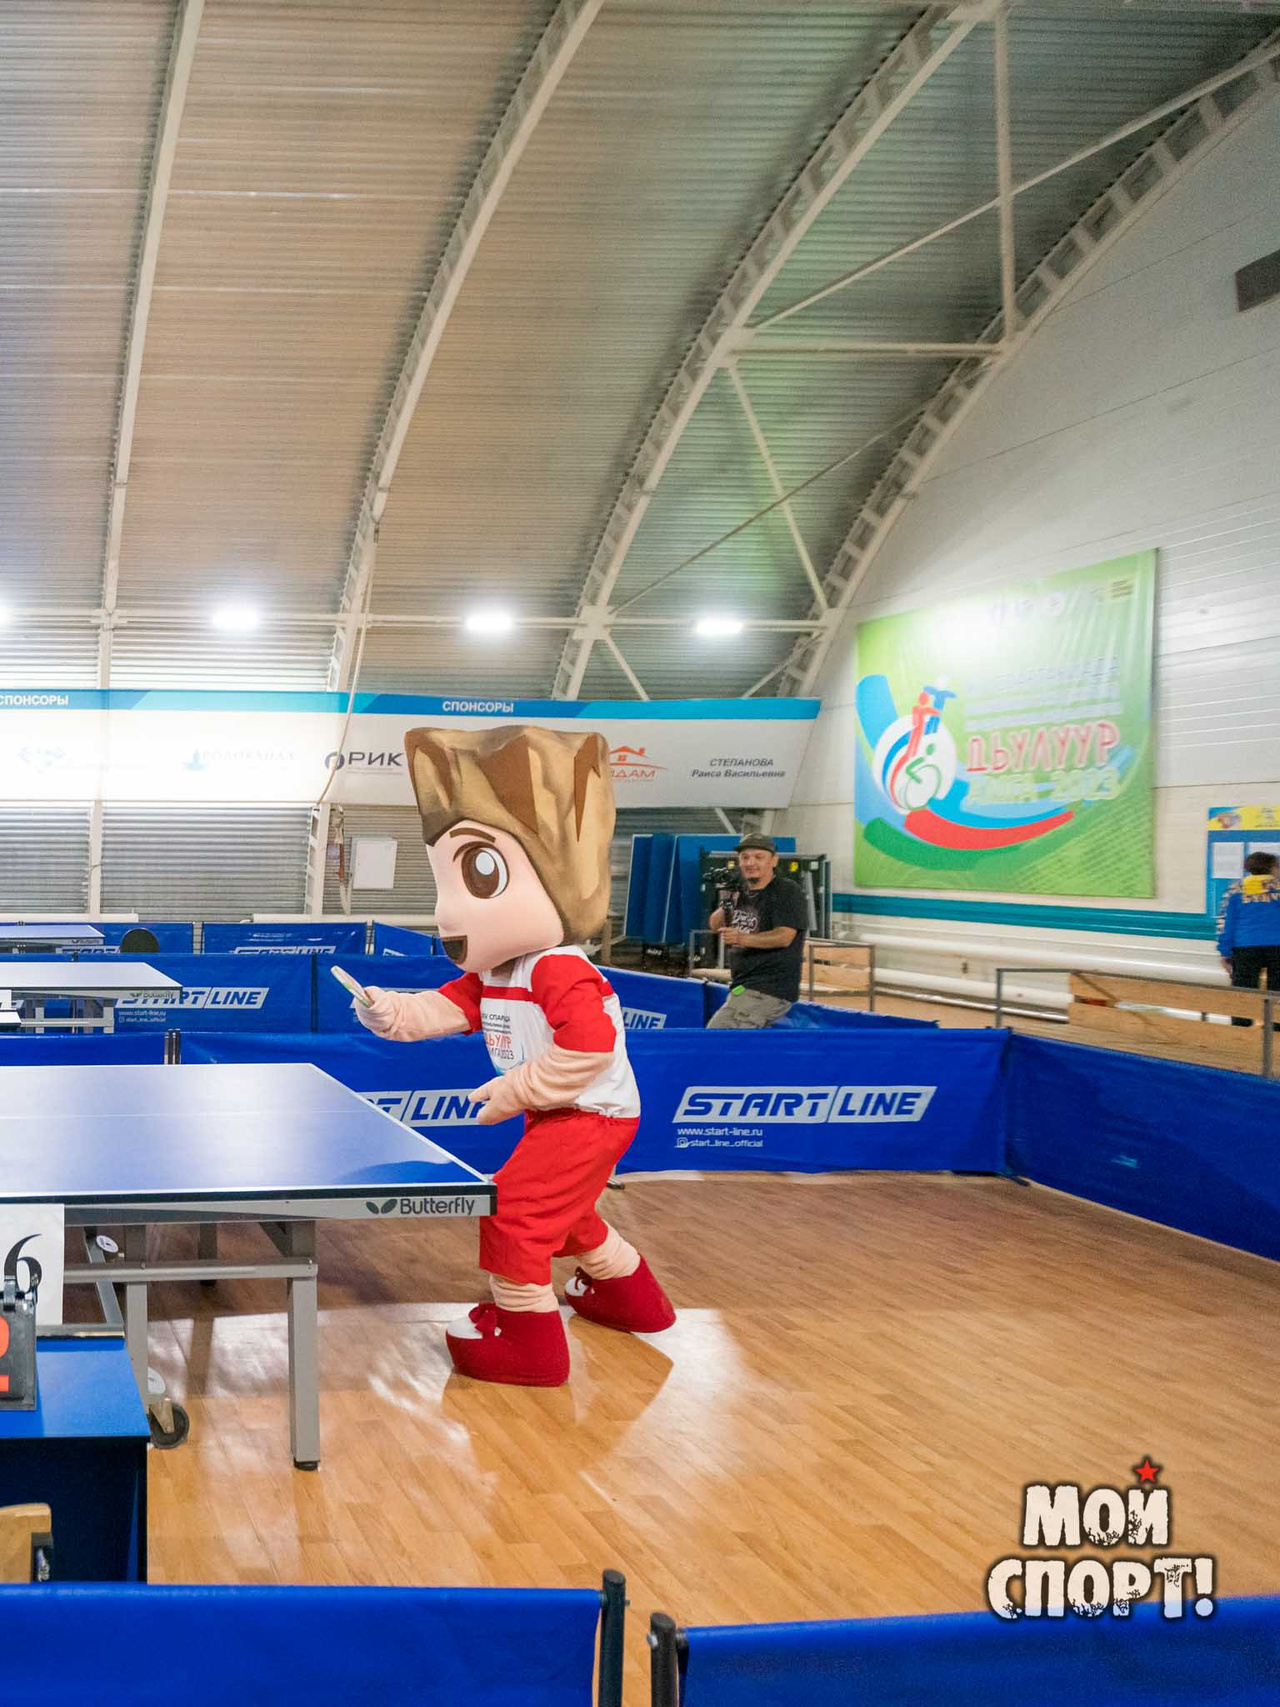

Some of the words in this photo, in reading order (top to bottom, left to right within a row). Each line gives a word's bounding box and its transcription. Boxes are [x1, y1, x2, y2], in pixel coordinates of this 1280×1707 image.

[442, 701, 514, 713] СПОНСОРЫ
[710, 758, 774, 767] СТЕПАНОВА
[691, 770, 721, 778] Раиса
[724, 770, 786, 778] Васильевна
[210, 991, 260, 1005] LINE
[623, 1011, 661, 1028] LINE
[683, 1092, 829, 1117] START
[837, 1092, 922, 1116] LINE
[677, 1127, 763, 1136] www.start-line.ru
[400, 1197, 475, 1216] Butterfly
[3, 1233, 42, 1295] 6
